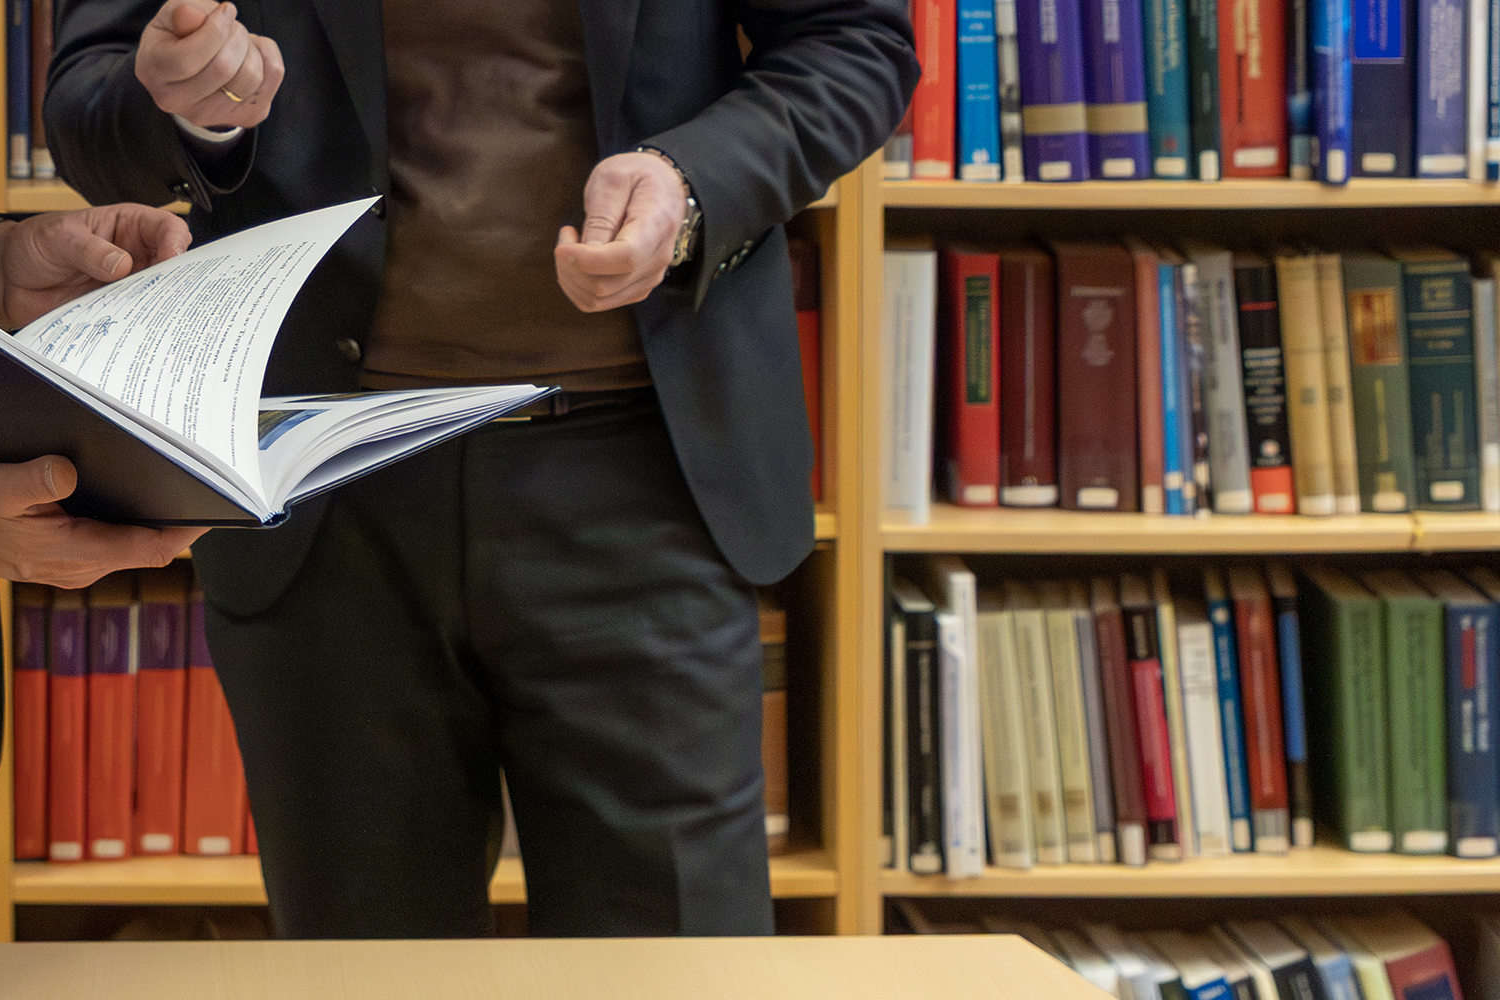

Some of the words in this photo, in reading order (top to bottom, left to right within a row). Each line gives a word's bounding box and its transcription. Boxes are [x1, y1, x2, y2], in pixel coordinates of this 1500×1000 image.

[247, 277, 276, 315] Inspeksjon
[242, 317, 250, 326] av
[222, 328, 246, 383] Treriksrøysa
